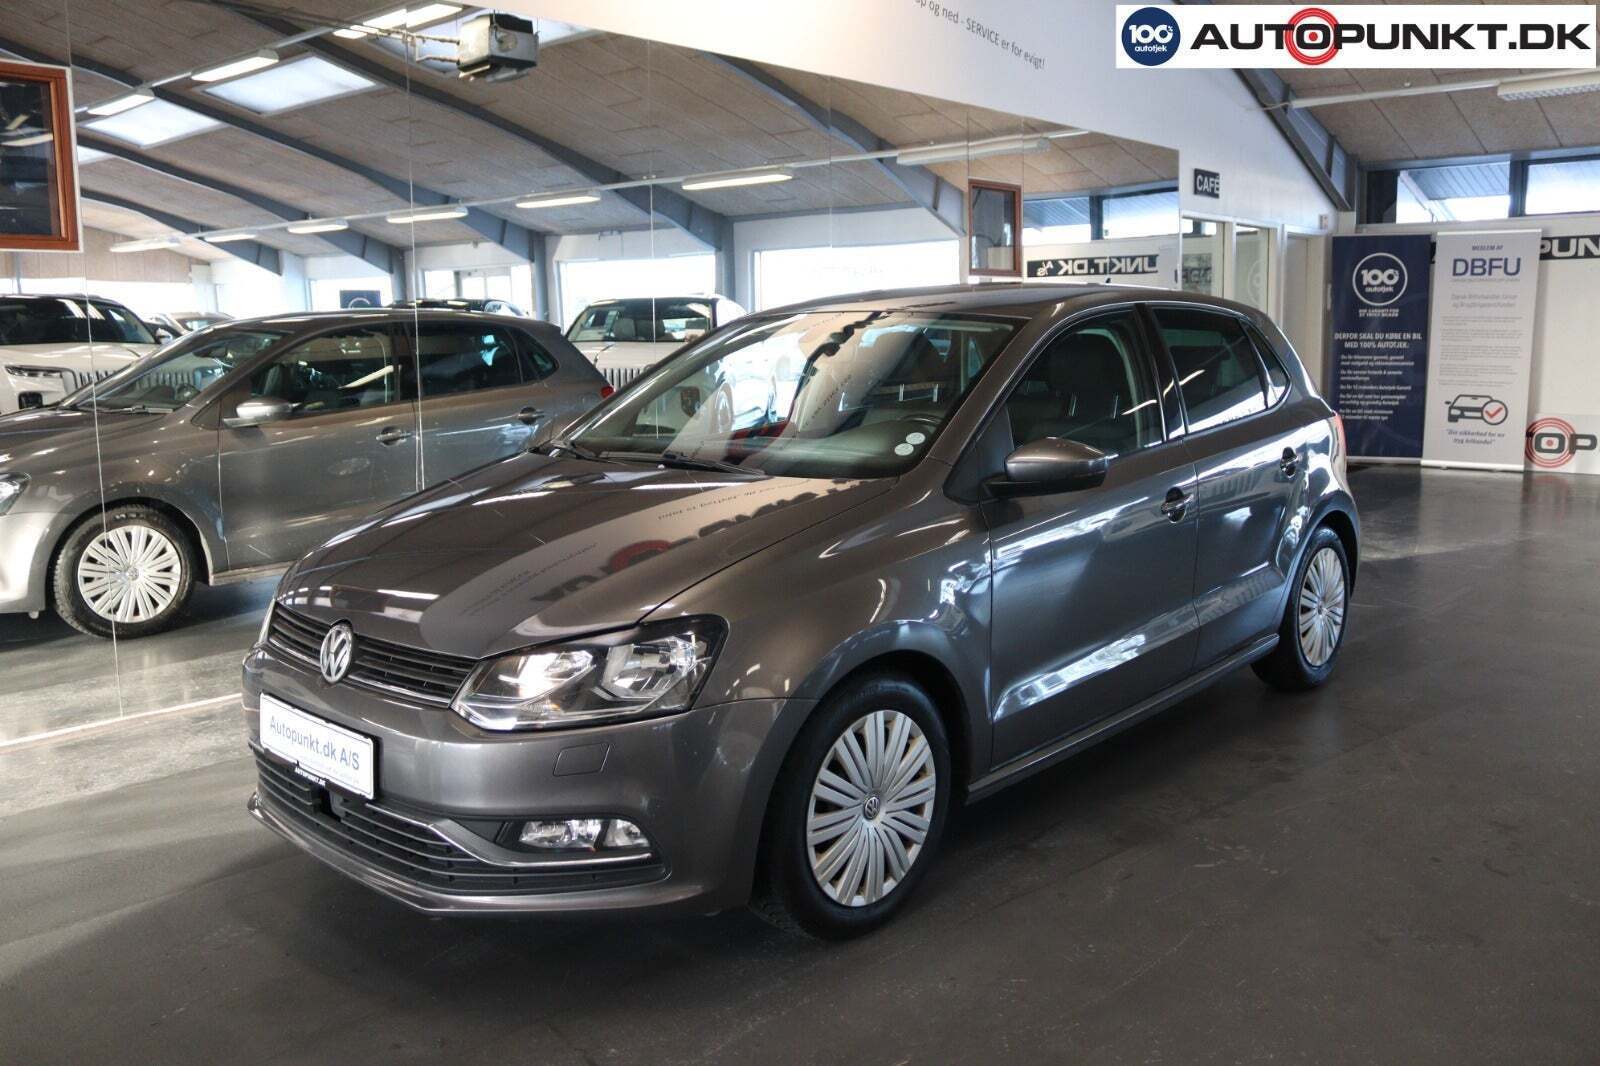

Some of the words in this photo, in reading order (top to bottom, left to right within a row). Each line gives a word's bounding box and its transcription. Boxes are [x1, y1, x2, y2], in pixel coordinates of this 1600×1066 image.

[929, 4, 940, 17] og
[942, 8, 959, 24] ned
[966, 17, 1000, 46] SERVICE
[1001, 38, 1010, 49] er
[1011, 42, 1022, 57] for
[1452, 257, 1522, 276] DBFU
[270, 715, 337, 761] Autopunkt.dk
[339, 746, 360, 771] A/S
